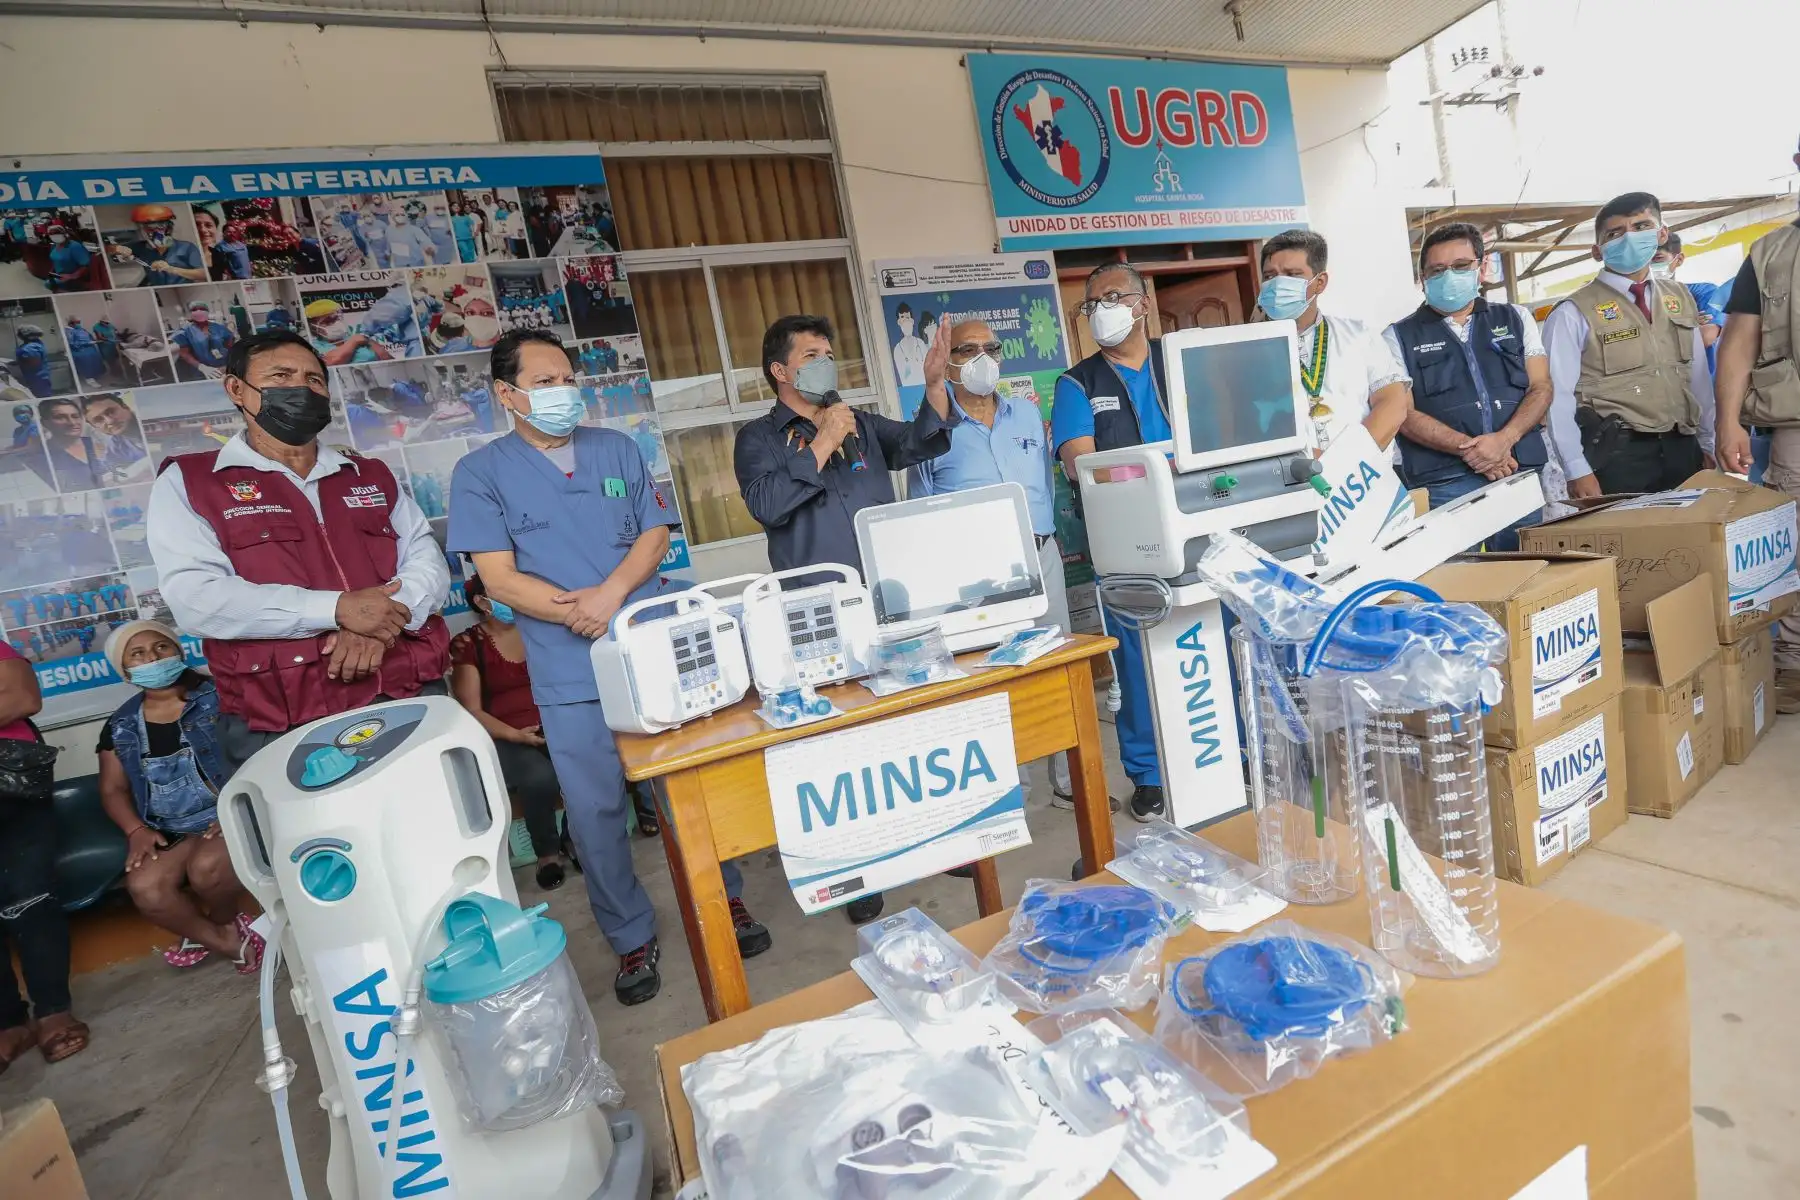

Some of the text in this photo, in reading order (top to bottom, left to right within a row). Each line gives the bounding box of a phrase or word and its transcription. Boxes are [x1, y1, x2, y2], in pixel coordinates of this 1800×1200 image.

[1107, 86, 1269, 148] UGRD
[82, 177, 147, 198] DE
[160, 175, 220, 195] LA
[231, 166, 481, 192] ENFERMERA
[1018, 179, 1099, 206] MINISTERIO DE SALUD
[1009, 209, 1297, 233] UNIDAD DE GESTION DEL RIESGO DE DESASTRE
[992, 309, 1002, 319] SE
[1003, 308, 1020, 319] SABE
[1135, 544, 1160, 552] MAQUET
[1735, 528, 1792, 572] MINSA
[1536, 613, 1598, 665] MINSA
[36, 657, 110, 690] ESIÓN
[1176, 621, 1223, 769] MINSA
[1541, 738, 1604, 795] MINSA
[797, 740, 997, 832] MINSA
